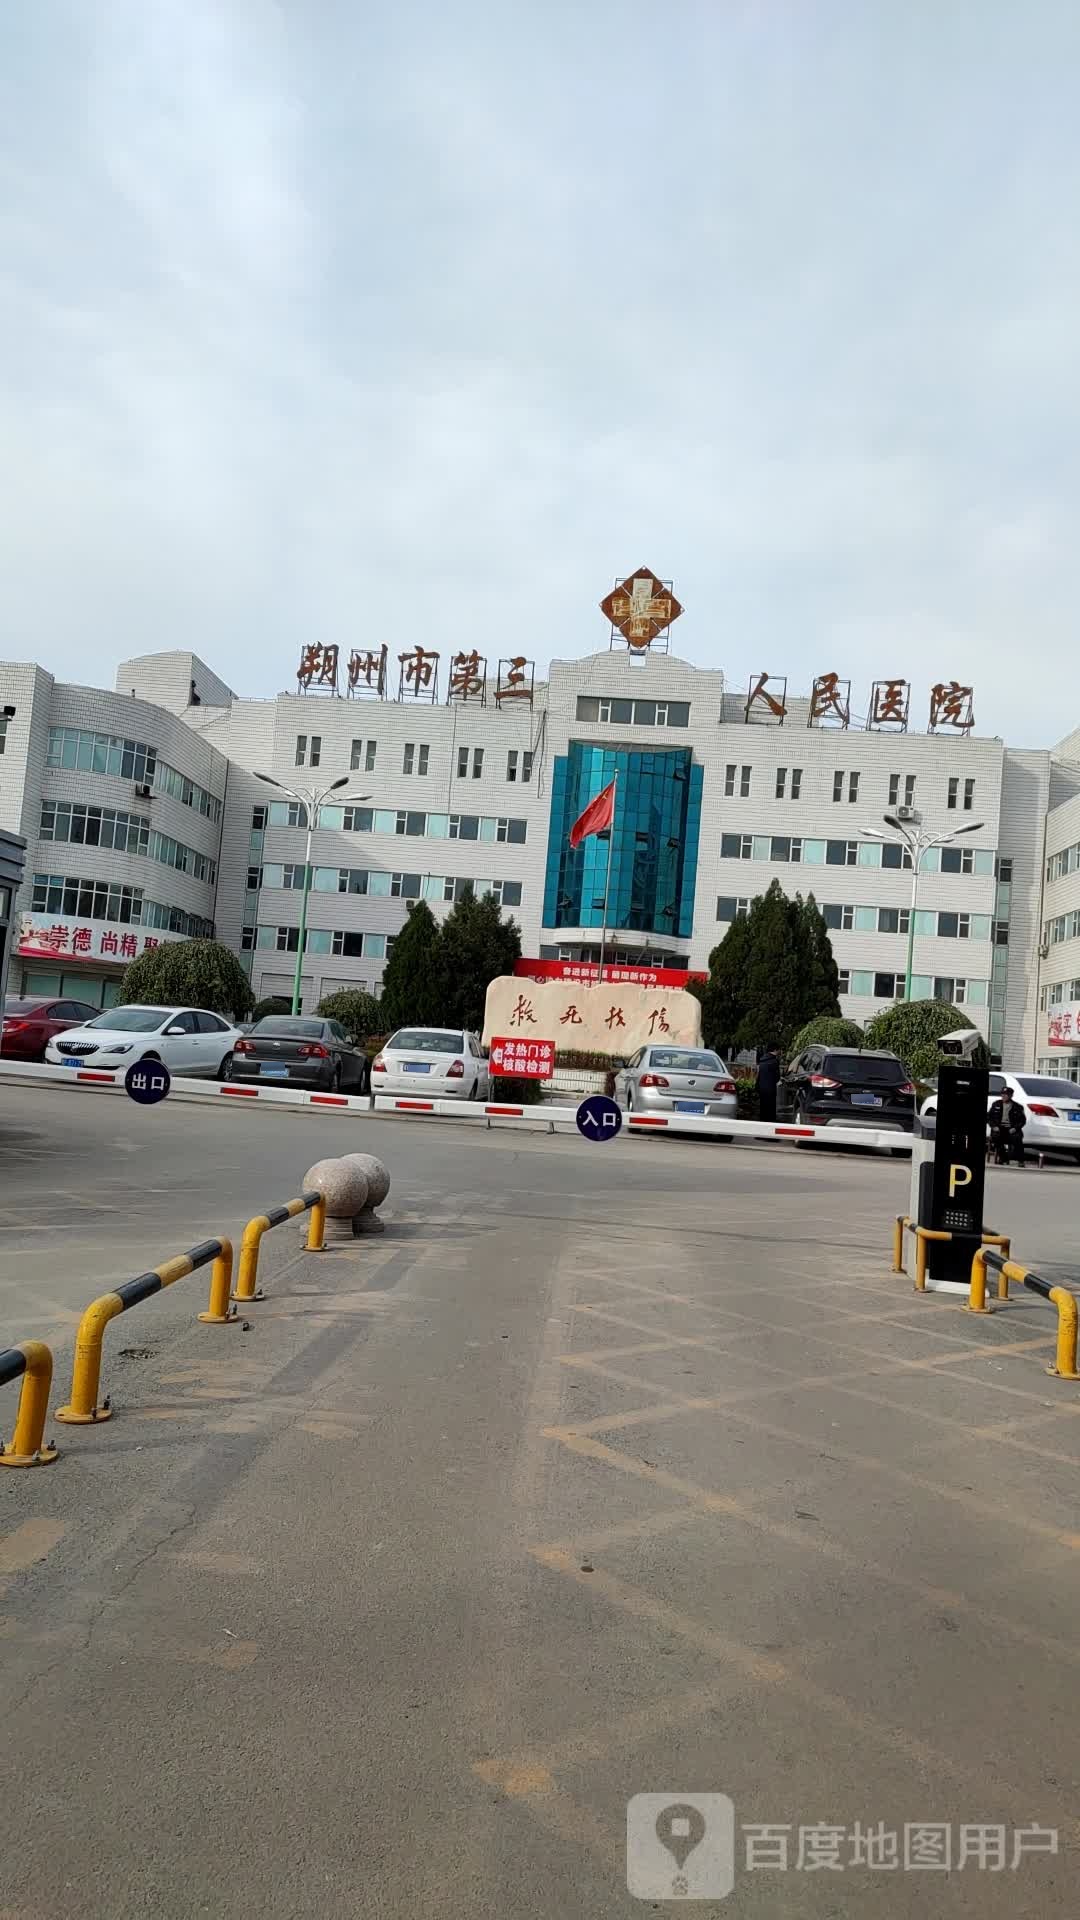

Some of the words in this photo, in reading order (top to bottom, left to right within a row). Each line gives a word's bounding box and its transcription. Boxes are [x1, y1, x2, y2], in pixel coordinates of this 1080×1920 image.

[297, 641, 533, 700] 朔州市第三
[744, 672, 975, 727] 人民医院
[504, 1042, 551, 1058] 发热门诊
[503, 1058, 550, 1074] 核酸检测
[131, 1072, 165, 1091] 出口
[582, 1109, 617, 1127] 入口
[949, 1163, 972, 1198] P
